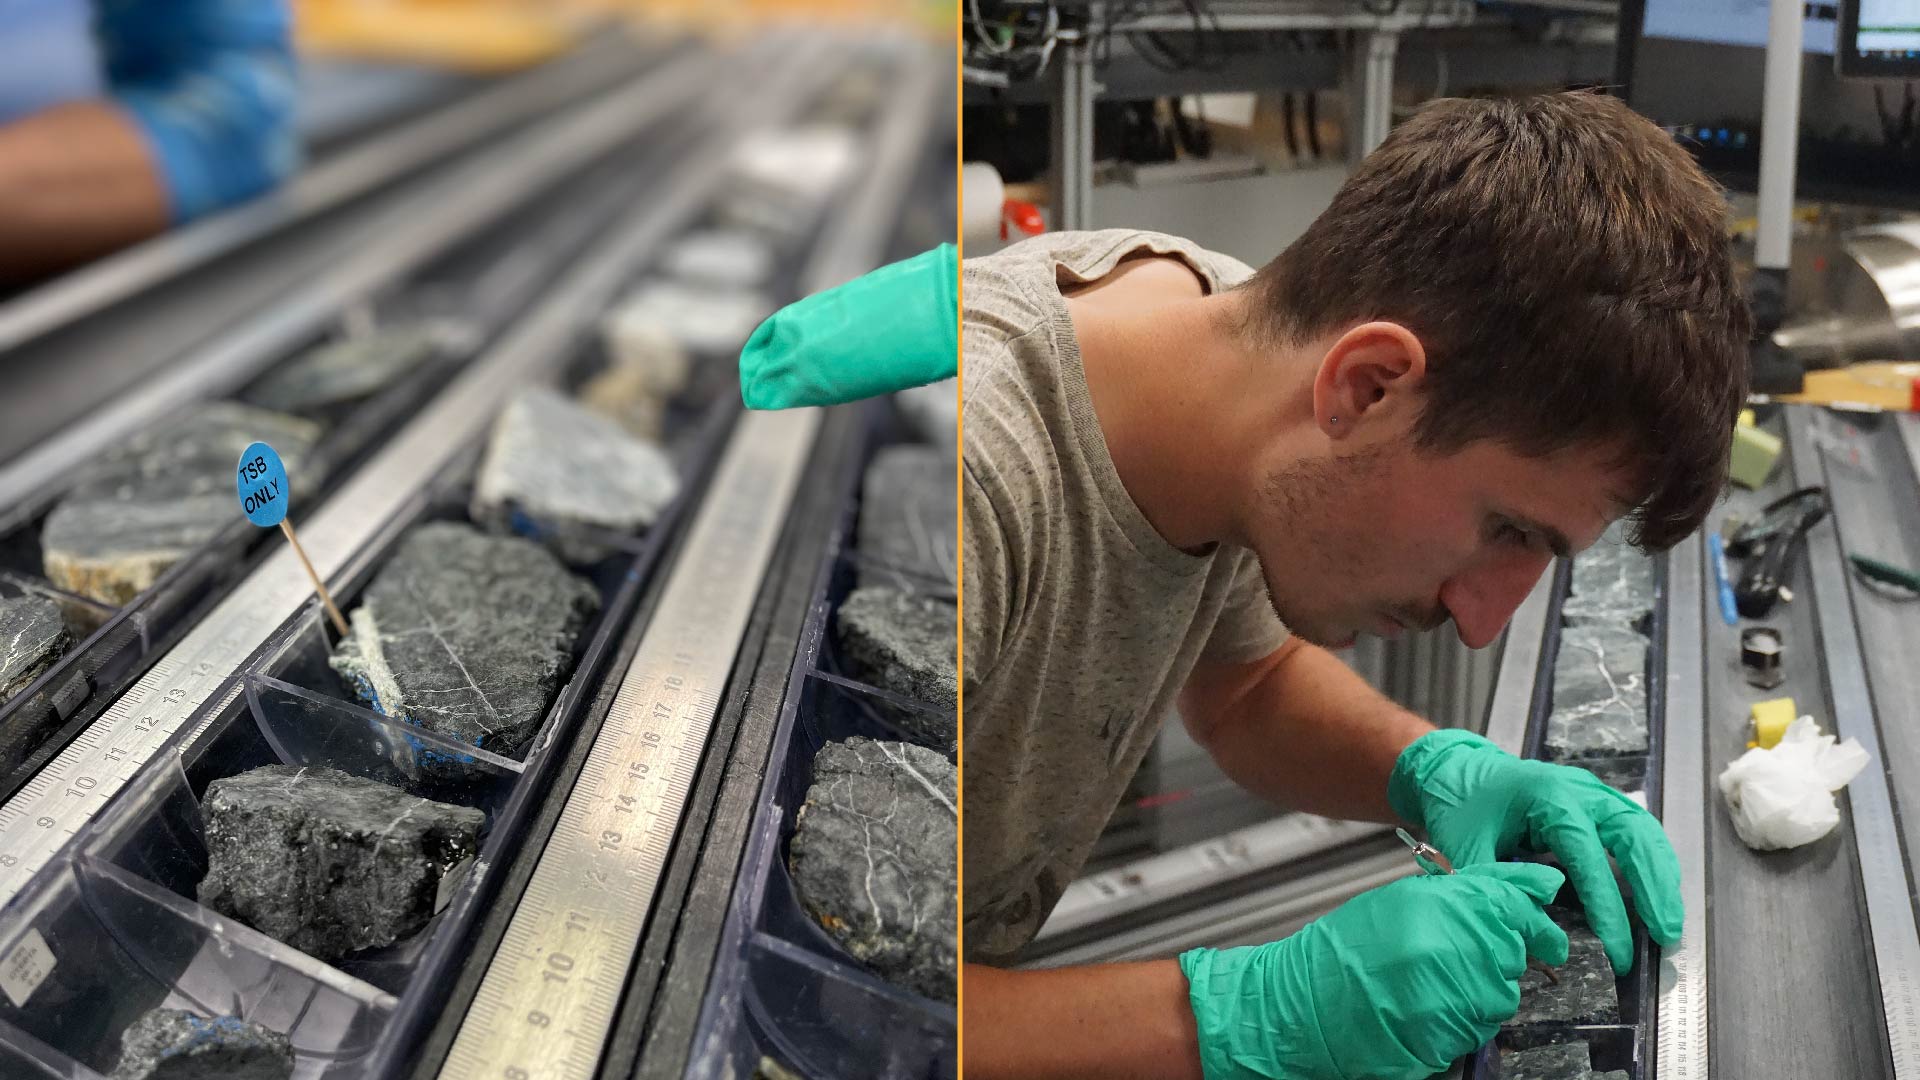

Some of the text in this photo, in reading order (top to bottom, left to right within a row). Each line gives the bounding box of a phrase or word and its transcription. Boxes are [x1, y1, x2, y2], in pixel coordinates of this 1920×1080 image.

[240, 456, 267, 484] TSB
[244, 477, 279, 514] ONLY
[0, 854, 18, 867] 8
[36, 816, 56, 829] 9
[65, 777, 97, 798] 10
[105, 747, 127, 761] 11
[134, 716, 160, 732] 12
[162, 688, 187, 704] 13
[527, 1010, 551, 1029] 9
[542, 952, 575, 982] 10
[565, 911, 590, 932] 11
[599, 830, 622, 850] 13
[614, 794, 637, 813] 14
[628, 762, 649, 780] 15
[640, 731, 661, 748] 16
[652, 701, 672, 719] 17
[664, 676, 683, 691] 18
